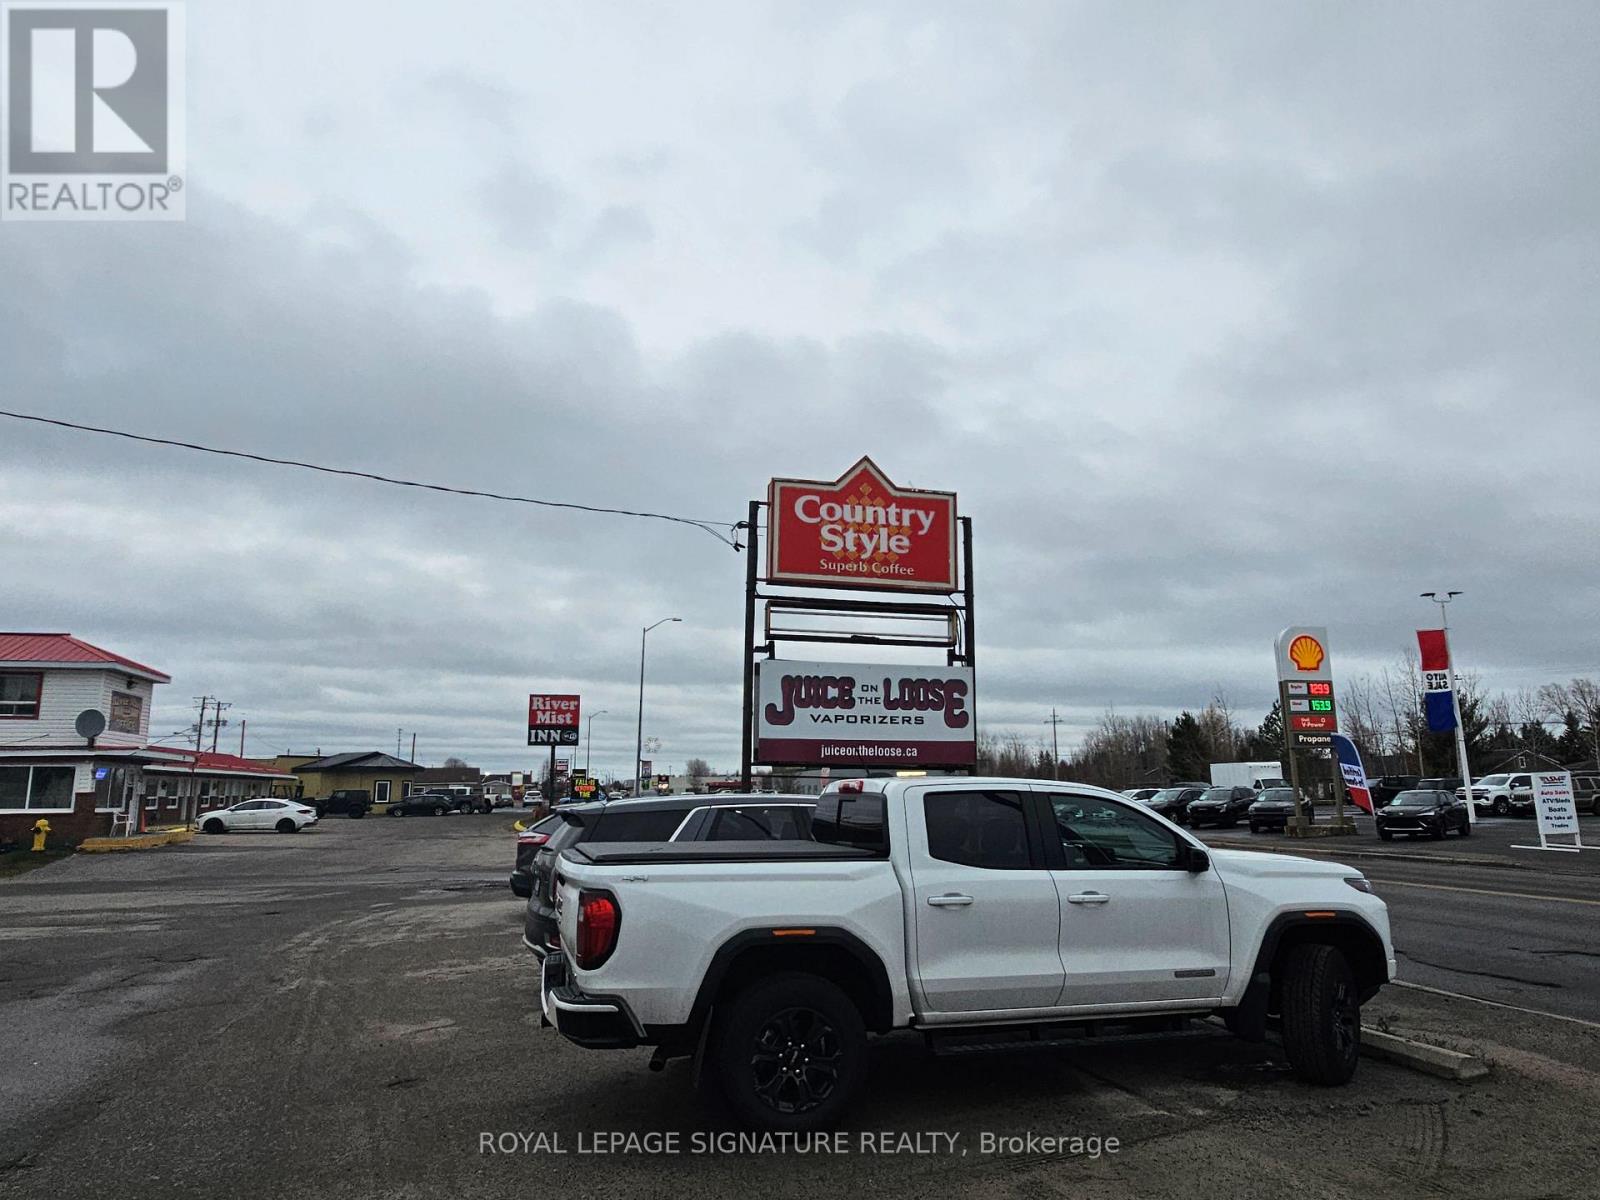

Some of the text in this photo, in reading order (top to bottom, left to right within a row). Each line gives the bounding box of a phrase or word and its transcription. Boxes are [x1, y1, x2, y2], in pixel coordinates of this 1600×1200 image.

[794, 494, 936, 535] Country
[820, 524, 910, 559] Style
[819, 558, 915, 575] Superb Coffee
[531, 696, 578, 710] River
[764, 674, 970, 729] JUICE ON THE LOOSE
[535, 710, 573, 724] Mist
[809, 713, 925, 725] VAPORIZERS
[530, 729, 561, 742] INN
[1298, 735, 1331, 744] Propane
